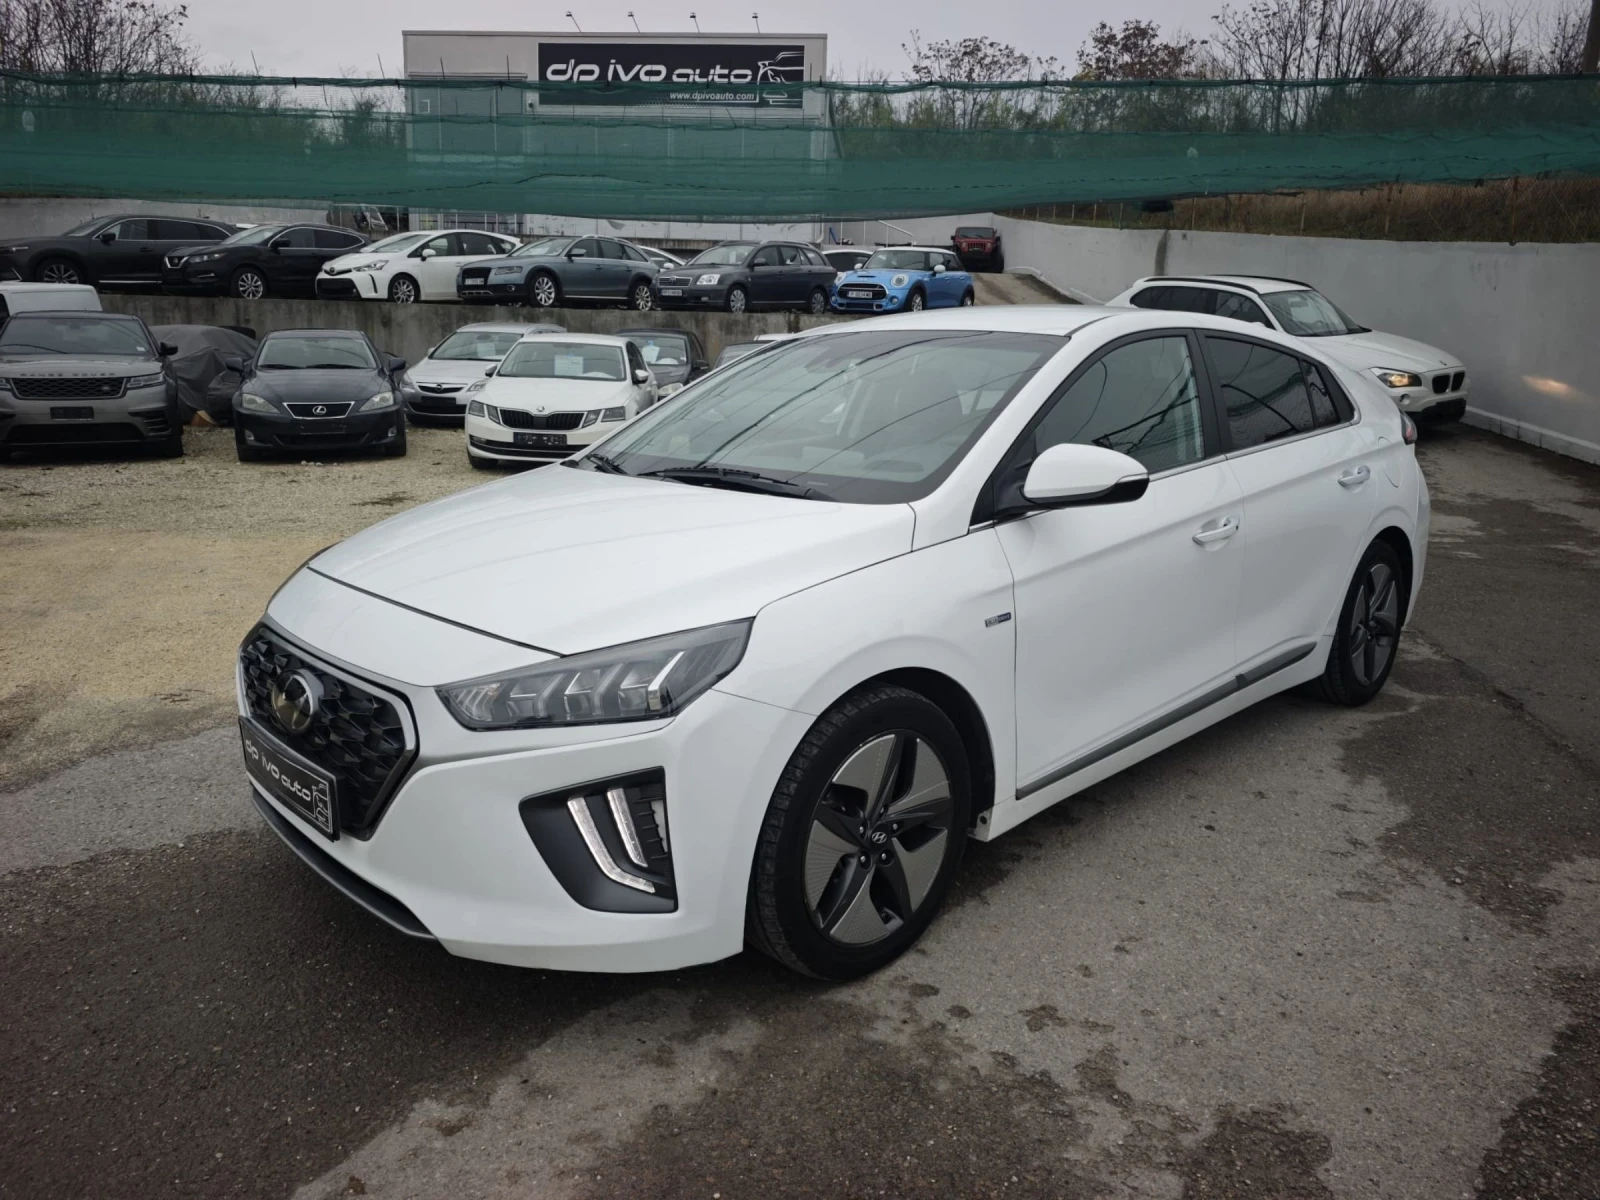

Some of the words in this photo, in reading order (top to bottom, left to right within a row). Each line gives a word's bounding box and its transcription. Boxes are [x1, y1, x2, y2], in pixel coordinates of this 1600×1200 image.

[546, 59, 600, 83] dp
[607, 59, 667, 82] ivo
[671, 65, 753, 83] auto
[669, 91, 755, 100] www.dpivoauto.com
[245, 739, 259, 760] dp
[261, 752, 280, 779] ivo
[281, 774, 312, 801] auto
